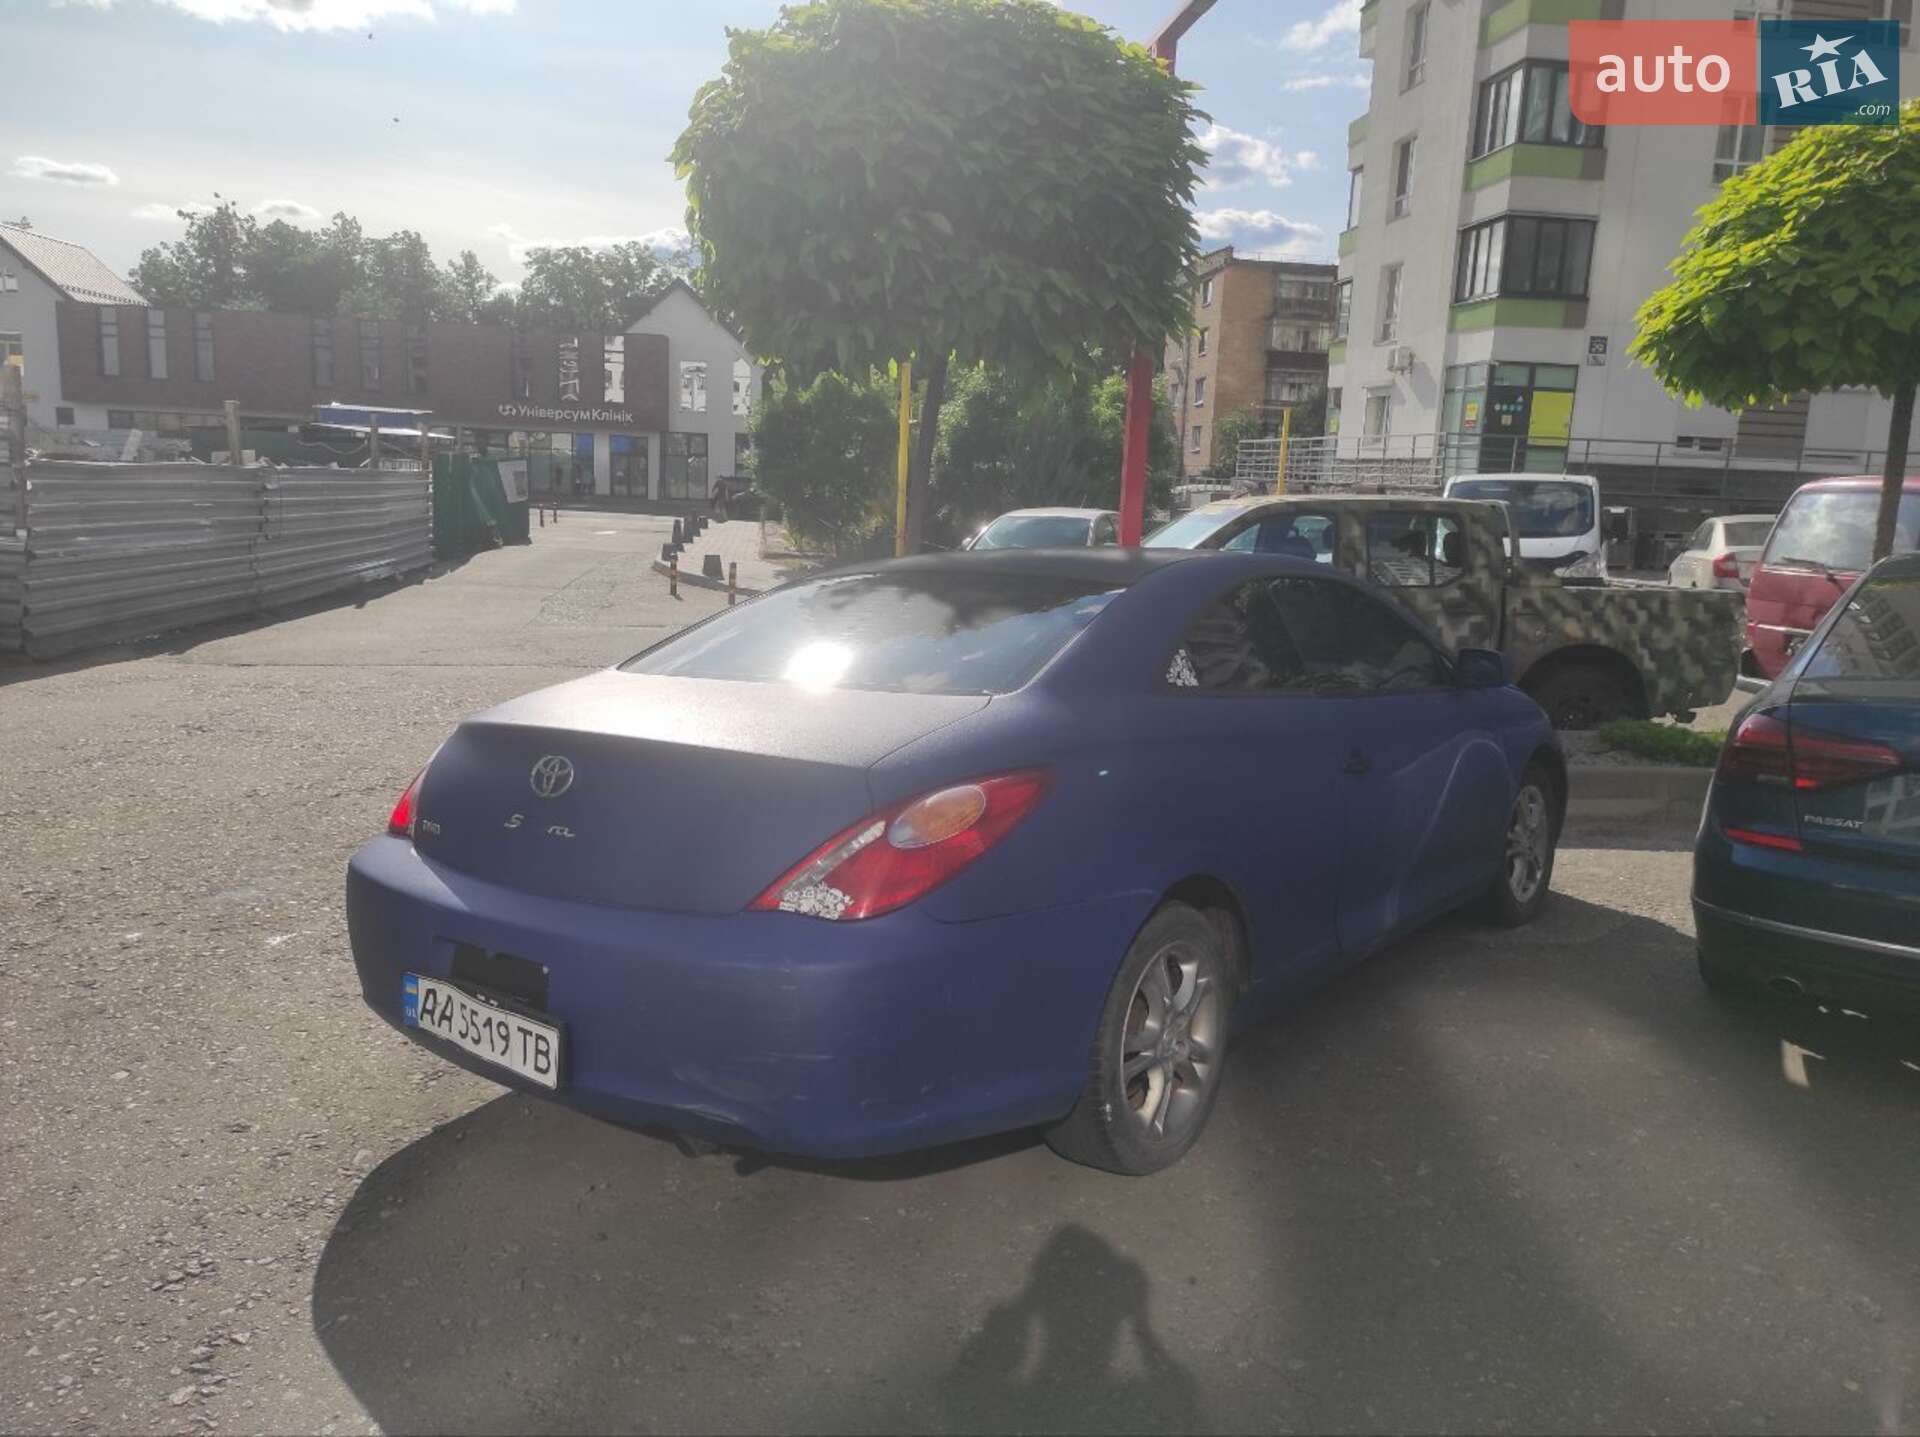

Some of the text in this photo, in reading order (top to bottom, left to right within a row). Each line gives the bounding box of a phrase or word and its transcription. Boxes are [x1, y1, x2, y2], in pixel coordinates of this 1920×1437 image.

[1803, 814, 1864, 829] PASSAT
[420, 988, 551, 1075] AA 5519 TB
